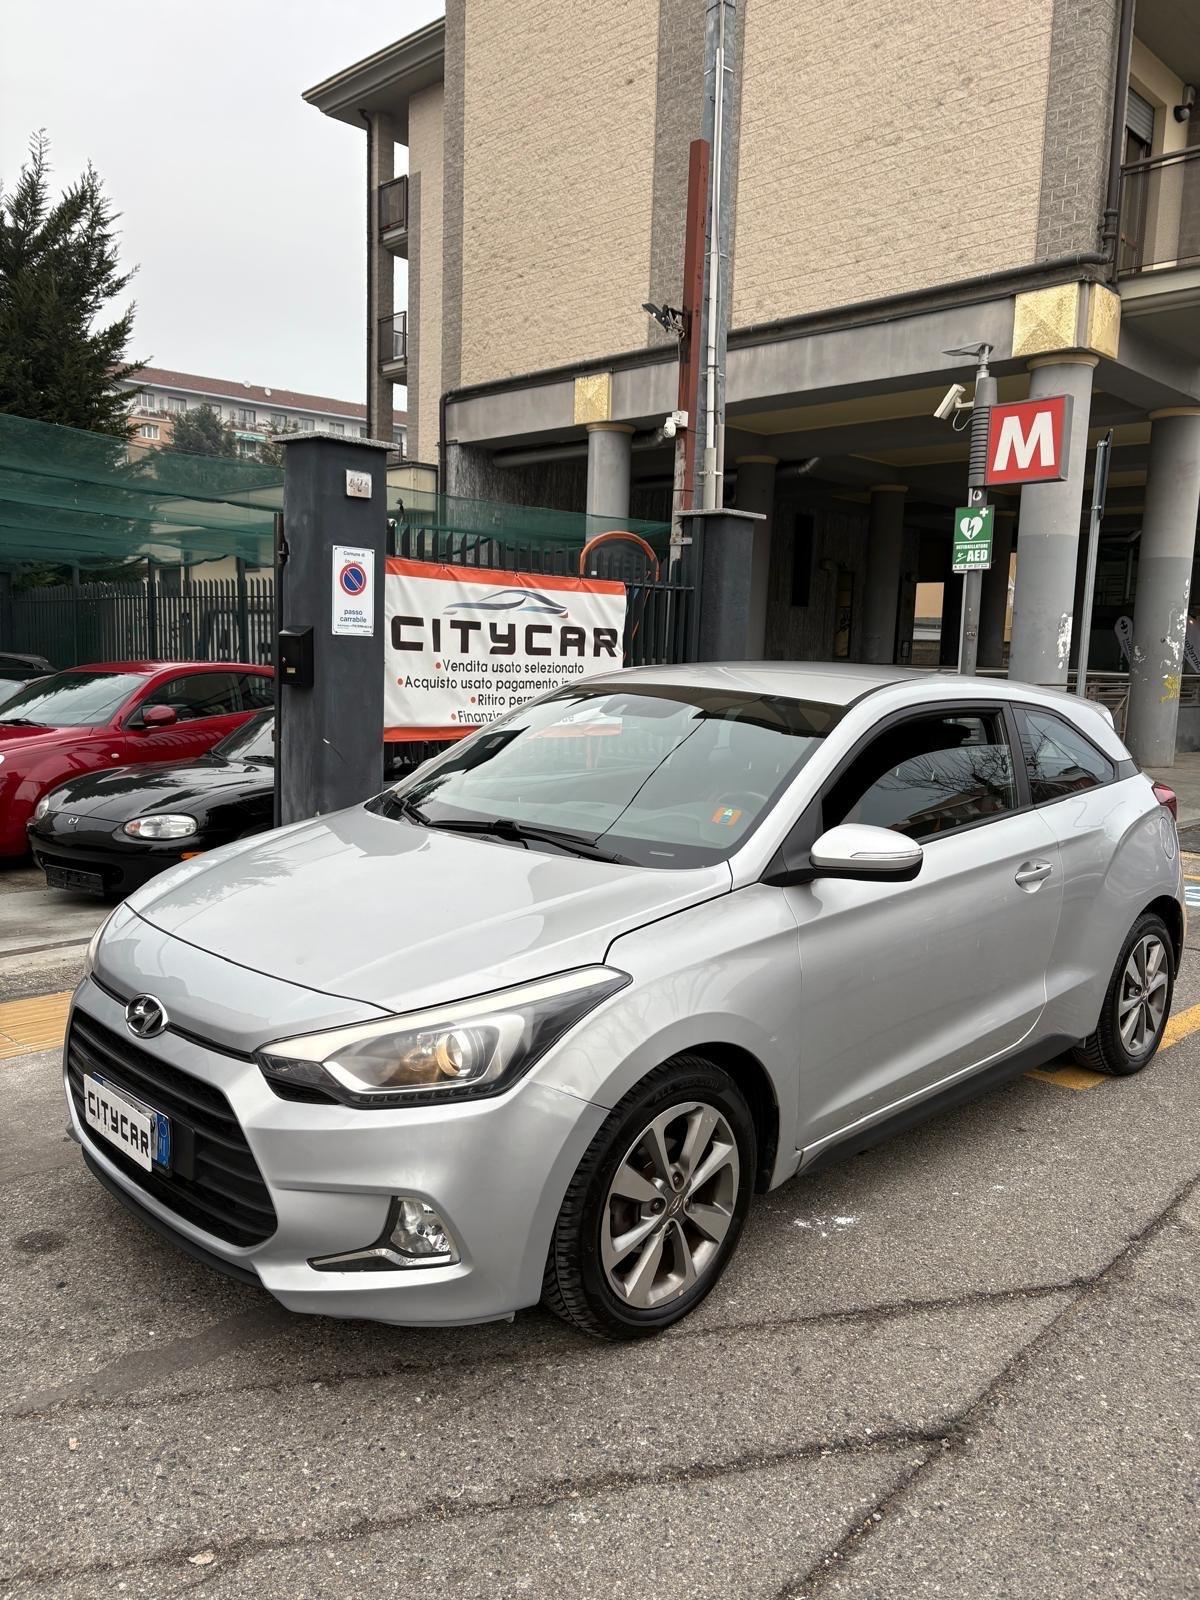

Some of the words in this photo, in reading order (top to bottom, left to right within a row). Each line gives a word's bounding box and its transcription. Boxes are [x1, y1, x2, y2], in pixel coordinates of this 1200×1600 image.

[992, 411, 1056, 472] M
[966, 549, 988, 562] AED
[391, 615, 618, 657] CITYCAR
[442, 659, 488, 673] Vendita
[492, 661, 521, 673] usato
[524, 661, 584, 674] selezionato
[405, 675, 457, 690] Acquisto
[461, 678, 492, 689] usato
[496, 677, 559, 692] pagamento
[477, 693, 505, 706] Ritiro
[88, 1090, 150, 1158] CITYCAR
